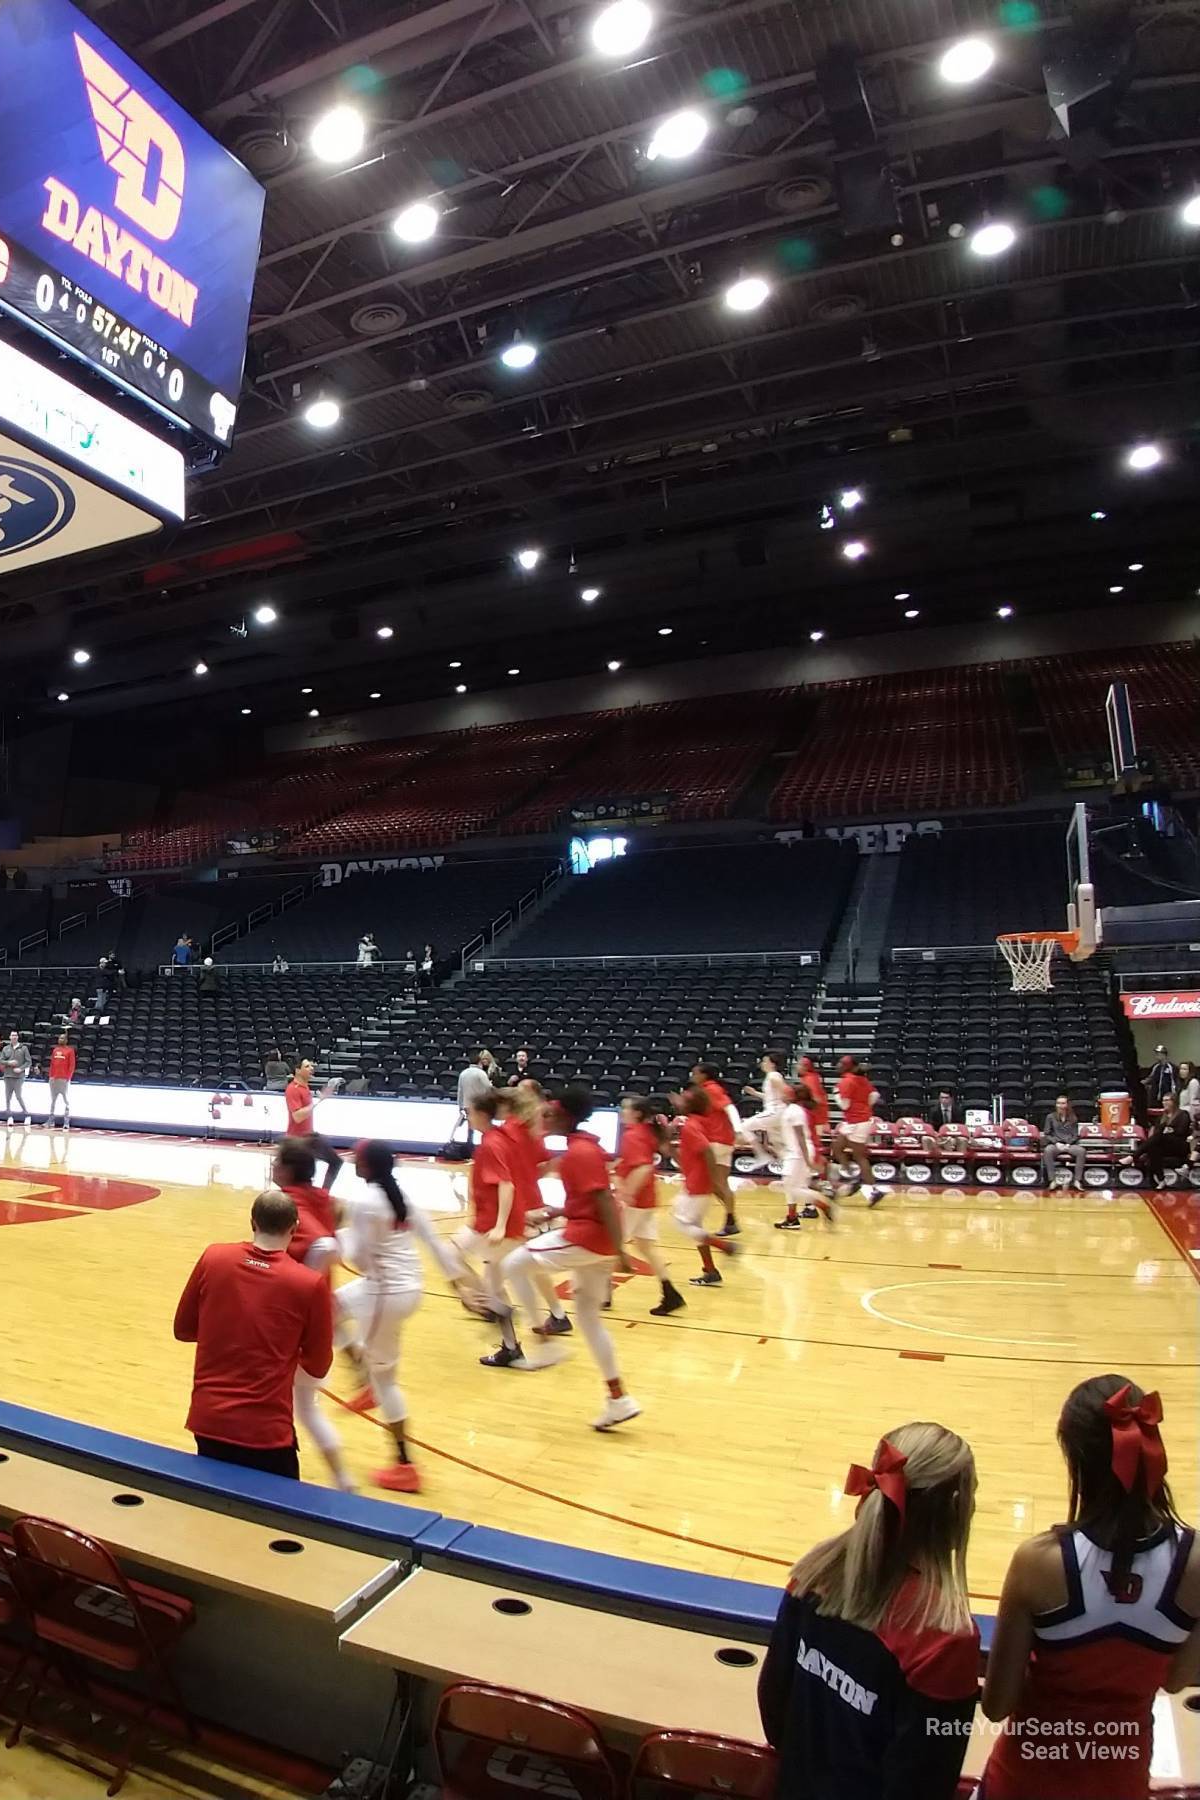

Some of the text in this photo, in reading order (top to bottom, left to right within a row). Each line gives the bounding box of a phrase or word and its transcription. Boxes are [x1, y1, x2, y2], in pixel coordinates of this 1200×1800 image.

[41, 176, 198, 328] DAYTON
[36, 274, 184, 402] 0 4 0 57:47 0 4 0
[101, 346, 121, 368] 1ST
